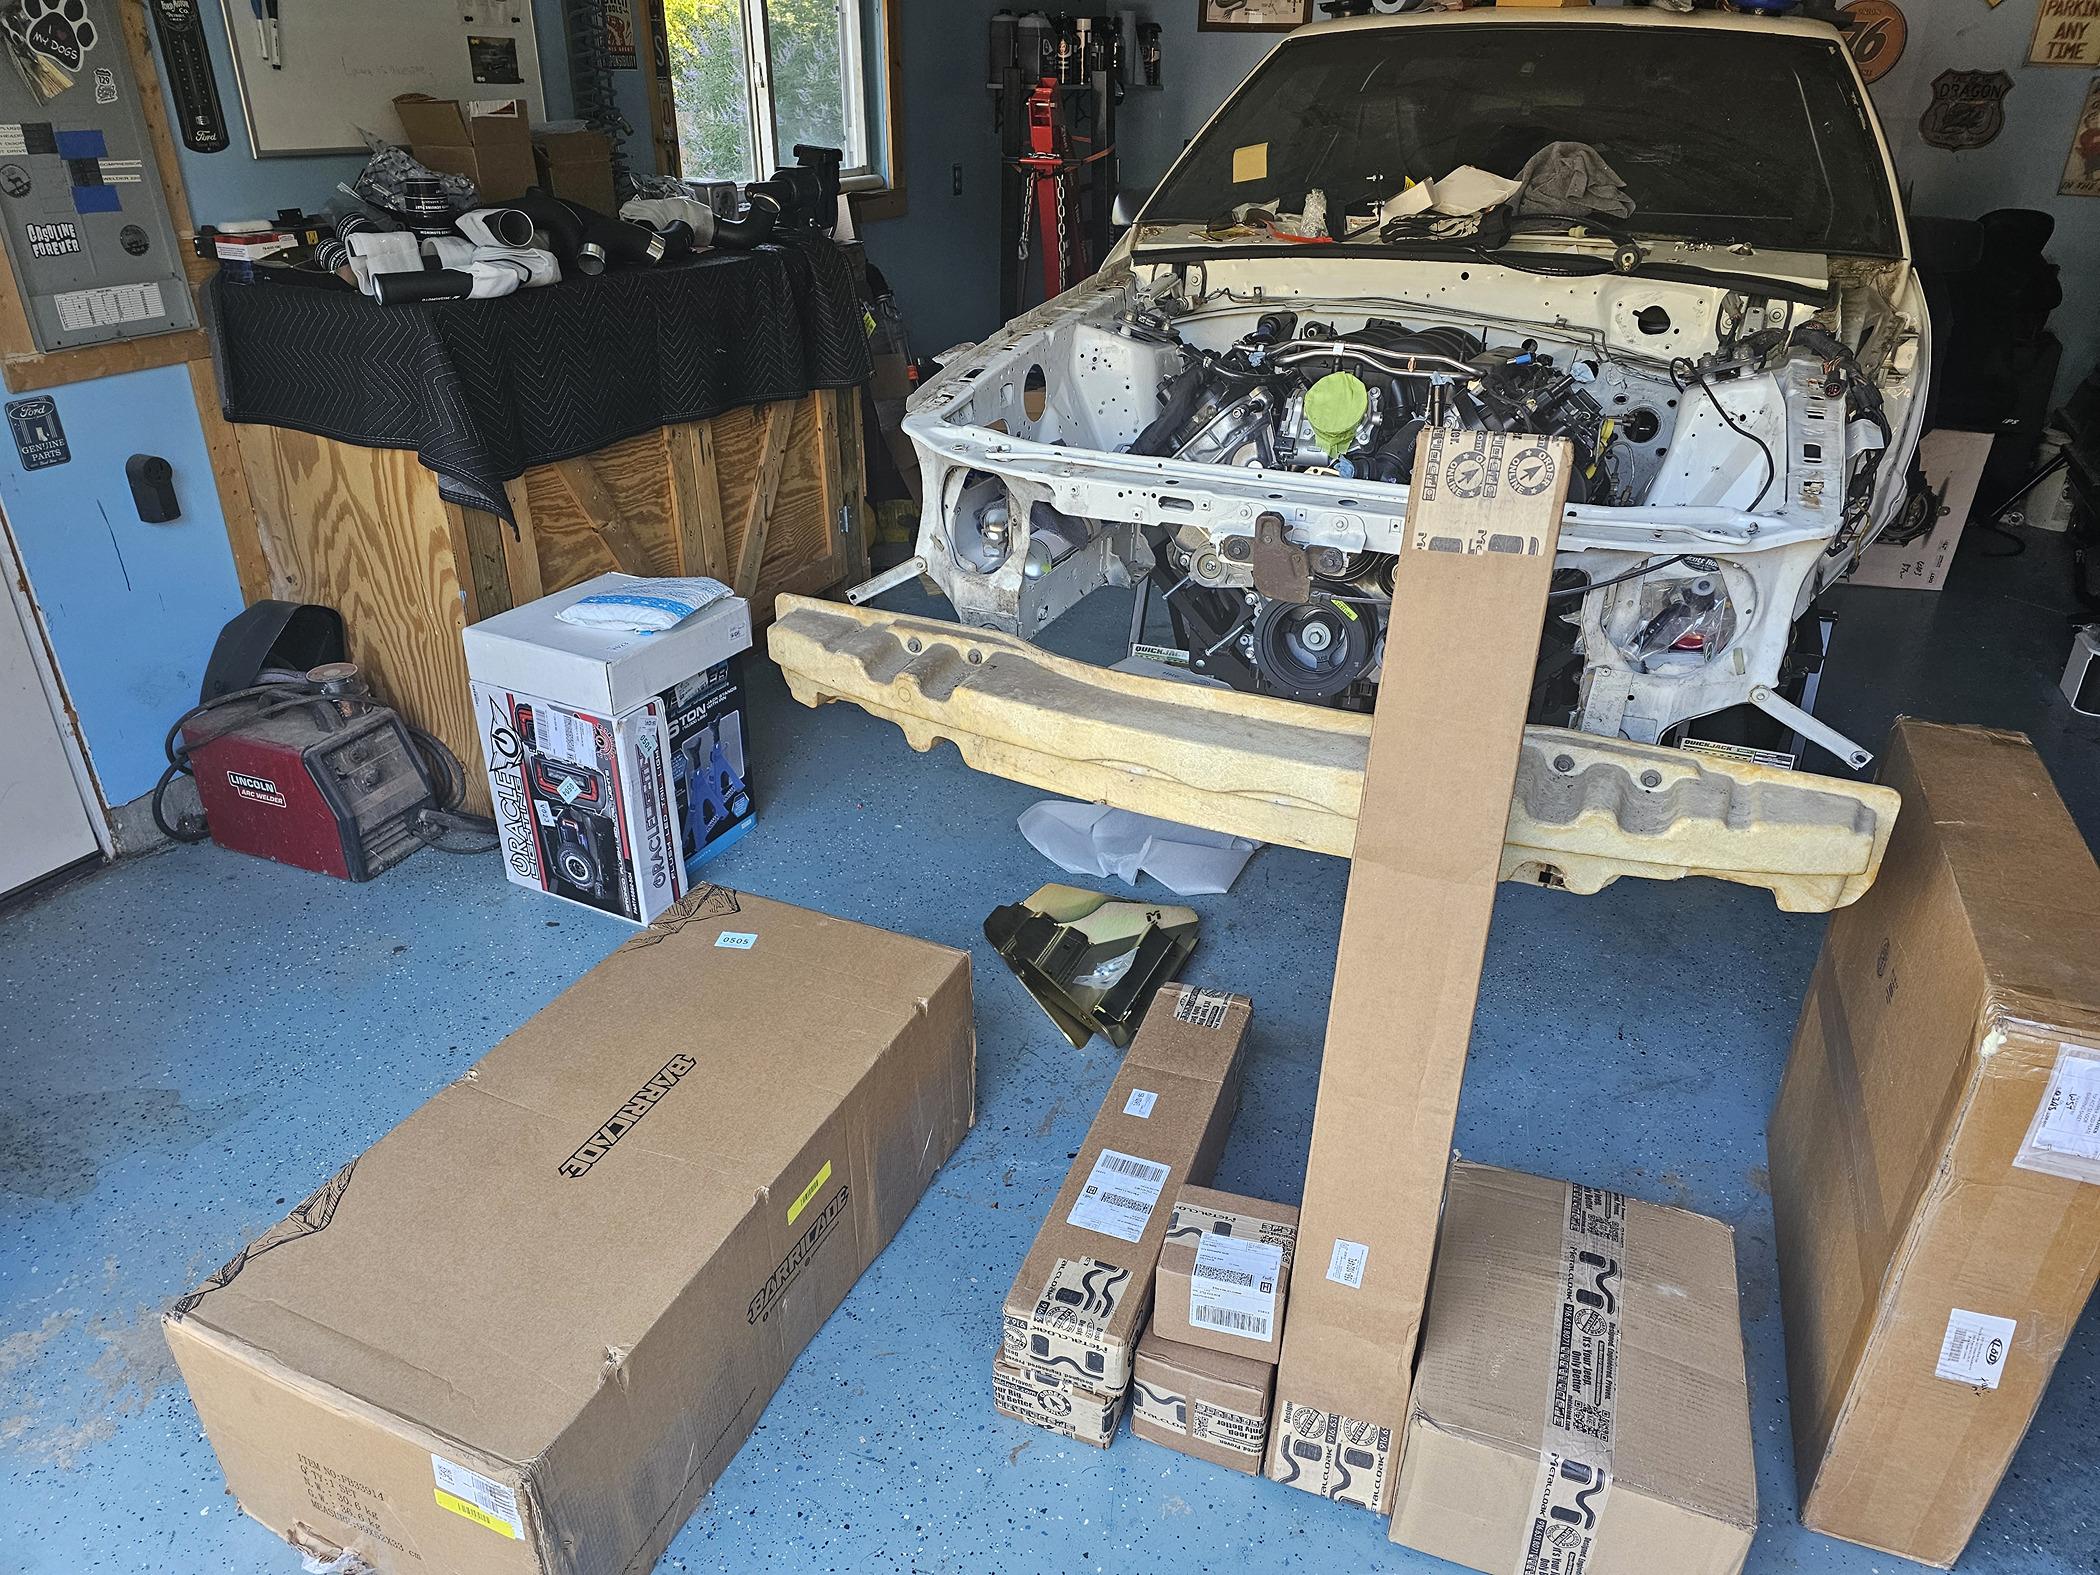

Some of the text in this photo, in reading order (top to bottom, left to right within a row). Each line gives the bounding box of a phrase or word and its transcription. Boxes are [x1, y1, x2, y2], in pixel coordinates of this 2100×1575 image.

[2053, 21, 2090, 40] ANY
[51, 39, 77, 60] DOGS
[2048, 41, 2088, 60] TIME
[1938, 84, 2002, 99] DRAGON
[195, 130, 216, 143] Ford
[27, 223, 76, 243] GASOLINE
[32, 239, 81, 258] FOREVER
[19, 403, 47, 417] Ford
[21, 438, 65, 455] GENUINE
[31, 449, 62, 462] PARTS
[1446, 461, 1464, 497] ONLINE
[1508, 458, 1525, 495] ONLINE
[1538, 452, 1555, 488] ORDER
[679, 703, 707, 723] TON
[1684, 738, 1735, 752] QUICKJACK
[230, 774, 276, 794] LINCOLN
[241, 788, 284, 806] ARC WELDER
[659, 785, 667, 812] TAIL
[494, 768, 531, 876] ORACLE
[513, 777, 540, 880] LIGHTING
[662, 813, 671, 837] LED
[646, 814, 668, 890] ORACLE
[665, 842, 677, 880] FLUSH
[723, 935, 749, 946] 0505
[558, 1053, 696, 1179] BARRICADE
[746, 1185, 849, 1326] BARRICADE
[1571, 1350, 1581, 1368] Only
[1582, 1348, 1592, 1366] Your
[297, 1452, 320, 1471] ITEM
[339, 1484, 357, 1499] SET
[364, 1505, 379, 1520] kg
[368, 1518, 382, 1532] kg
[408, 1550, 422, 1561] cm
